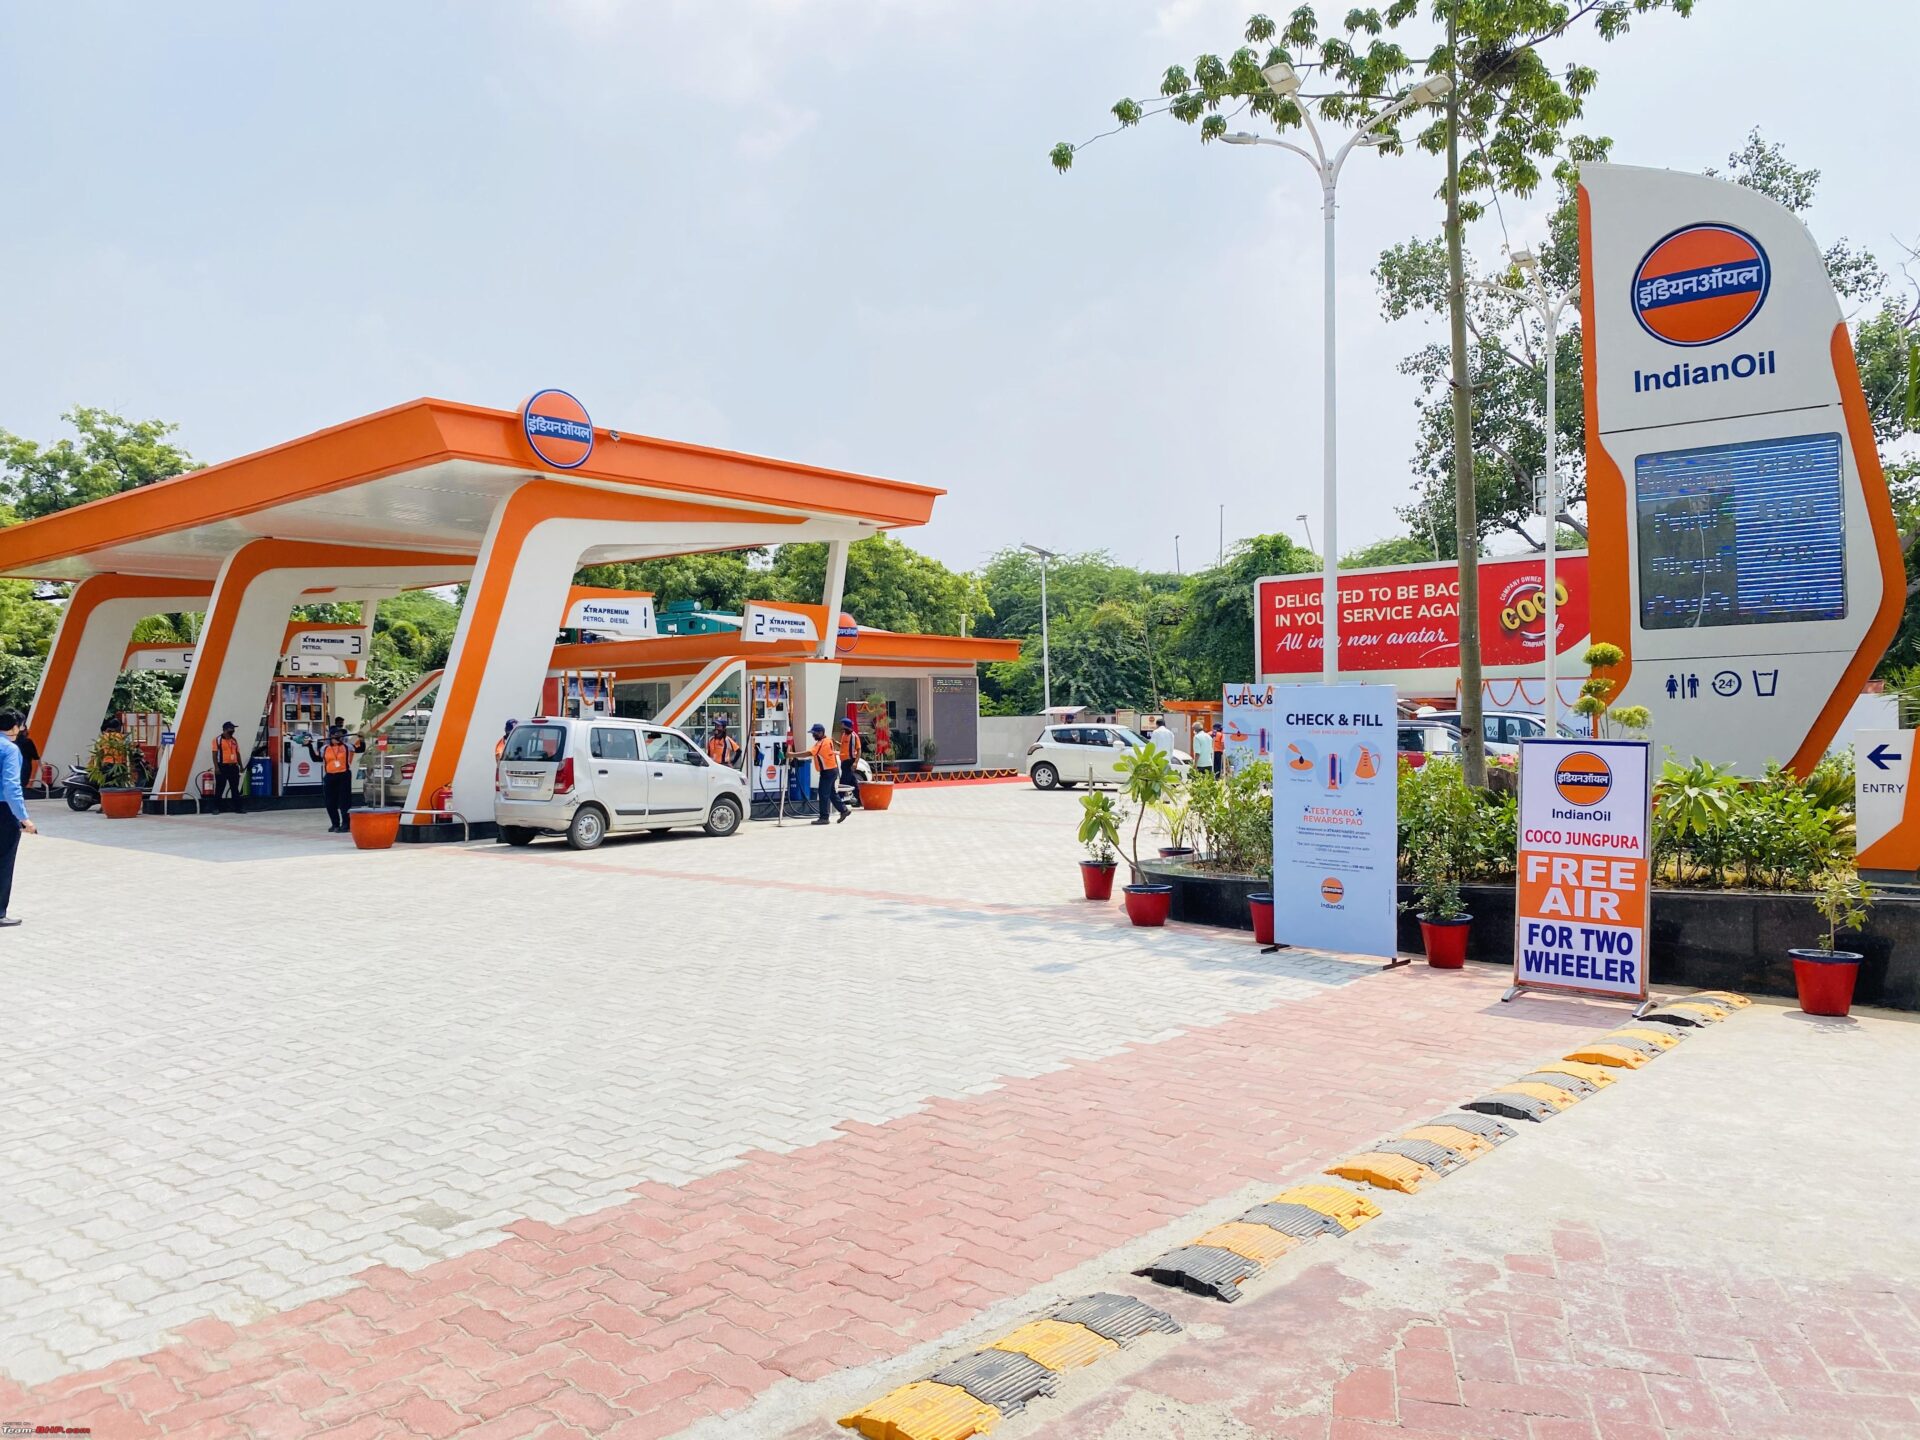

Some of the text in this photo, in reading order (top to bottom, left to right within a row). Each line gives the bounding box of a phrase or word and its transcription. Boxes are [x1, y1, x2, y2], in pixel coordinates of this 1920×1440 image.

[1638, 266, 1761, 308] इंडियनऑयल
[1634, 350, 1776, 393] IndianOil
[528, 415, 591, 439] इंडियनऑयल
[1275, 581, 1460, 609] DELIGTED TO BE BAC
[582, 615, 629, 625] PETROL DIESEL
[755, 613, 765, 636] 2
[1275, 602, 1460, 628] IN YOU SERVICE AGAI
[350, 635, 362, 654] 3
[1275, 632, 1304, 653] All
[1347, 633, 1383, 647] new
[290, 655, 300, 671] 6
[1227, 694, 1264, 705] CHECK
[1285, 713, 1384, 728] CHECK & FILL
[1557, 772, 1609, 785] इंडियनऑयल
[1861, 783, 1905, 794] ENTRY
[1303, 814, 1363, 827] REWARDS PAO
[1311, 806, 1356, 818] TEST KARO
[1551, 807, 1612, 823] IndianOil
[1525, 829, 1640, 850] COCO JUNGPURA
[1525, 854, 1637, 892] FREE
[1537, 886, 1622, 922] AIR
[1527, 923, 1634, 957] FOR TWO
[1523, 949, 1636, 985] WHEELER
